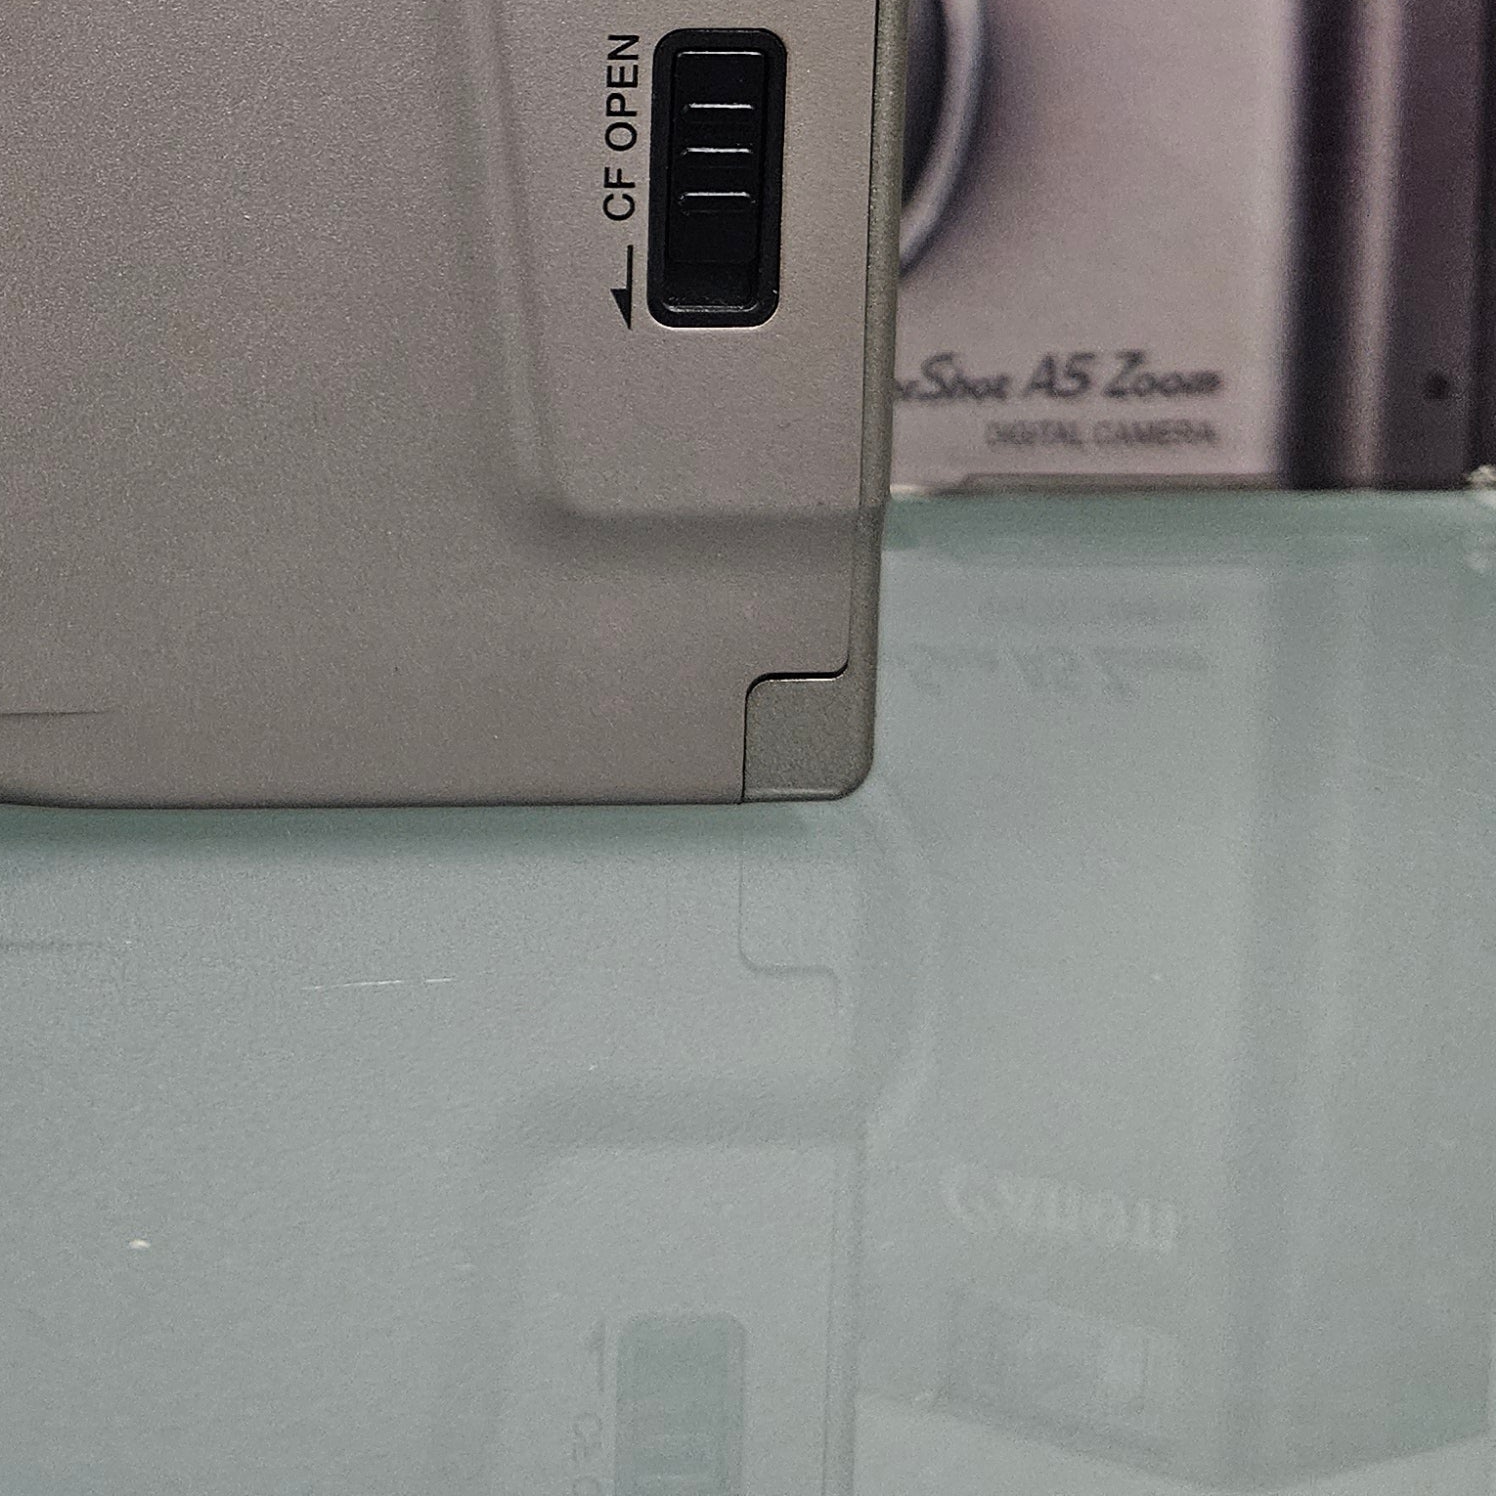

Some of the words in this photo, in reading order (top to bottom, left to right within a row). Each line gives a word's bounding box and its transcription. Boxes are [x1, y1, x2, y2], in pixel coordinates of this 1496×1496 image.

[604, 34, 640, 152] OPEN
[603, 166, 636, 222] CF
[1022, 351, 1098, 399] A5
[1102, 348, 1224, 399] Zoom
